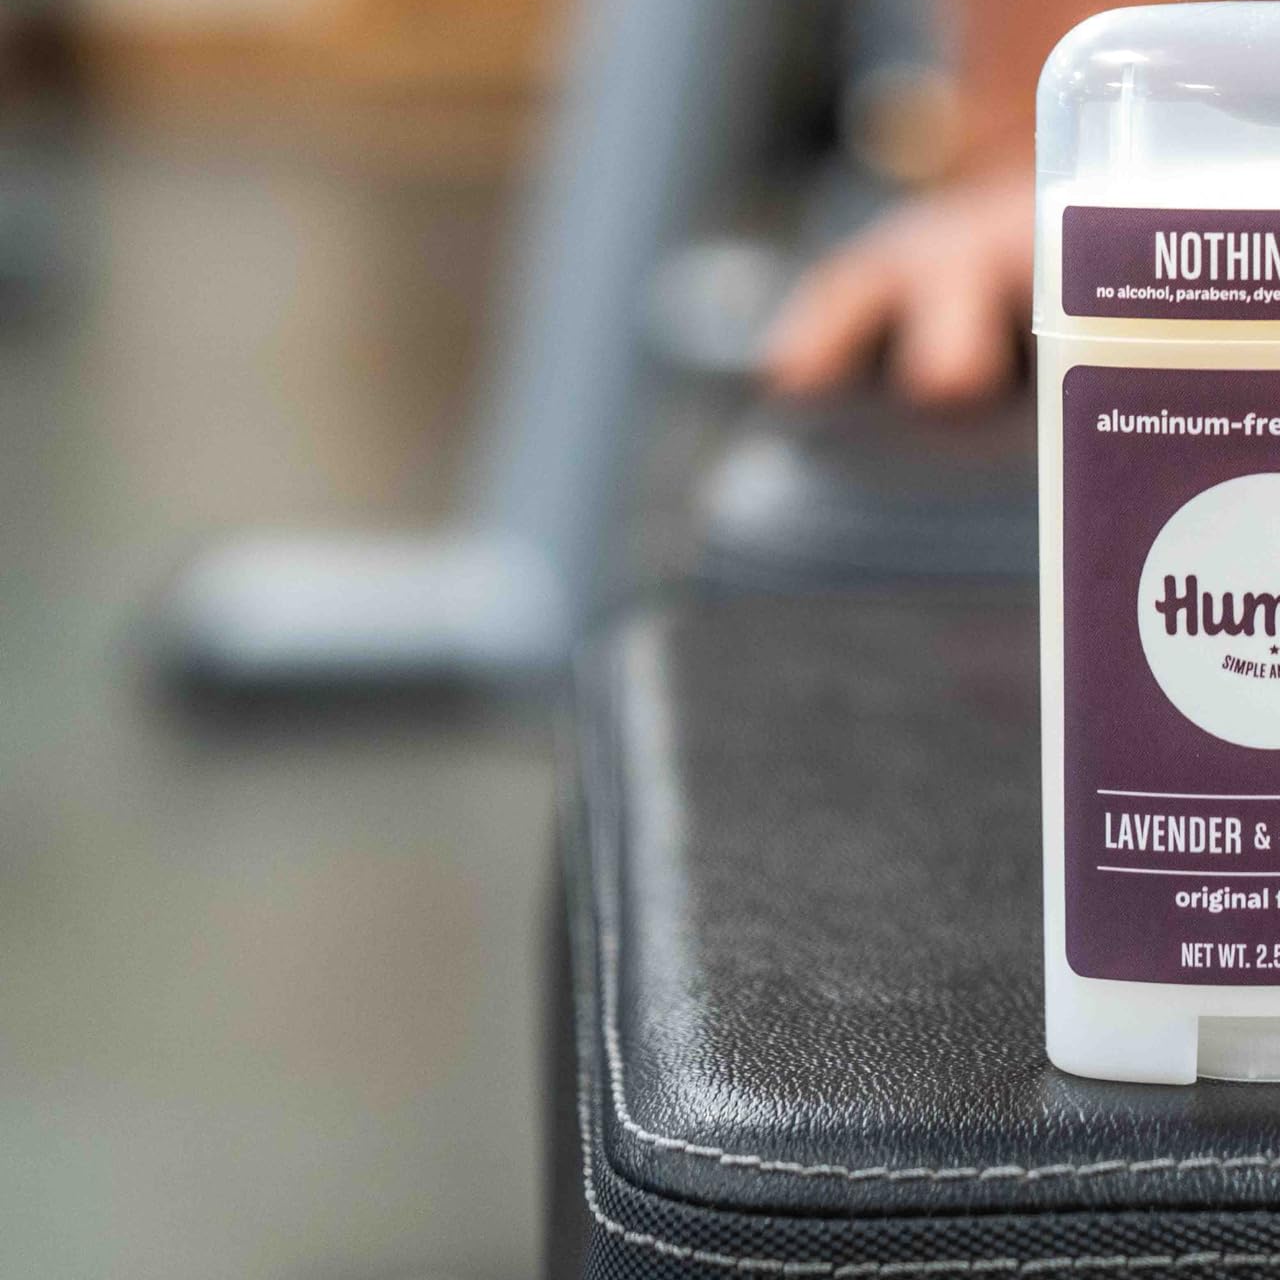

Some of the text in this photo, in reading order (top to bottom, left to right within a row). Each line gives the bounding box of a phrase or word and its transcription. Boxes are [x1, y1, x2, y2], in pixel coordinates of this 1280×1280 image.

[1096, 287, 1114, 299] no
[1117, 285, 1174, 303] alcohol,
[1176, 287, 1251, 304] parabens,
[1222, 654, 1266, 679] SIMPLE
[1105, 812, 1242, 854] LAVENDER
[1253, 822, 1271, 850] &
[1175, 886, 1269, 913] original
[1181, 942, 1213, 968] NET
[1218, 943, 1251, 968] WT.
